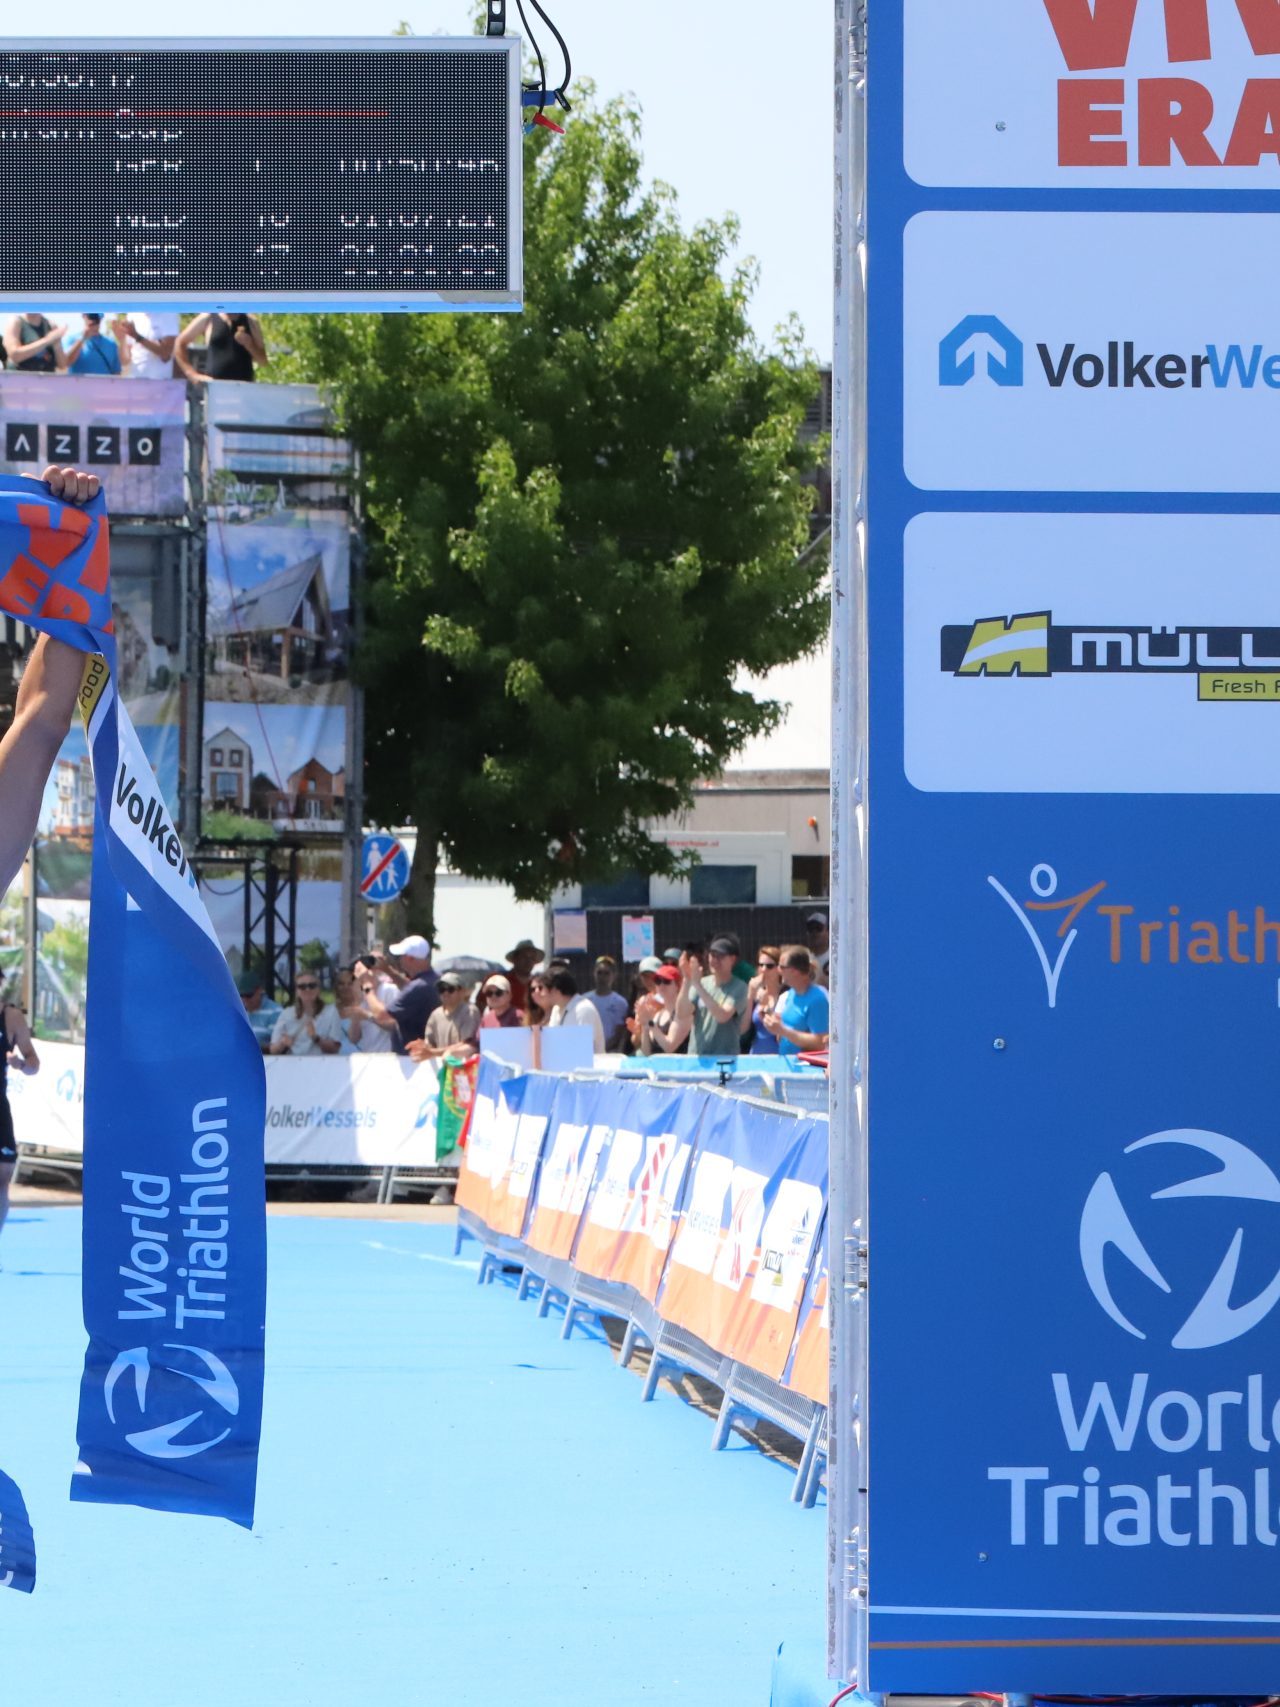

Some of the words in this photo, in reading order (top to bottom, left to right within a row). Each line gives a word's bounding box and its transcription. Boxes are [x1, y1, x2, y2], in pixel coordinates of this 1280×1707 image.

[1057, 77, 1280, 167] ERA
[1211, 678, 1267, 694] Fresh
[116, 762, 196, 890] Volker
[117, 1170, 172, 1320] World
[175, 1096, 230, 1330] Triathlon
[1051, 1373, 1280, 1453] Worl
[987, 1466, 1280, 1547] Triathl
